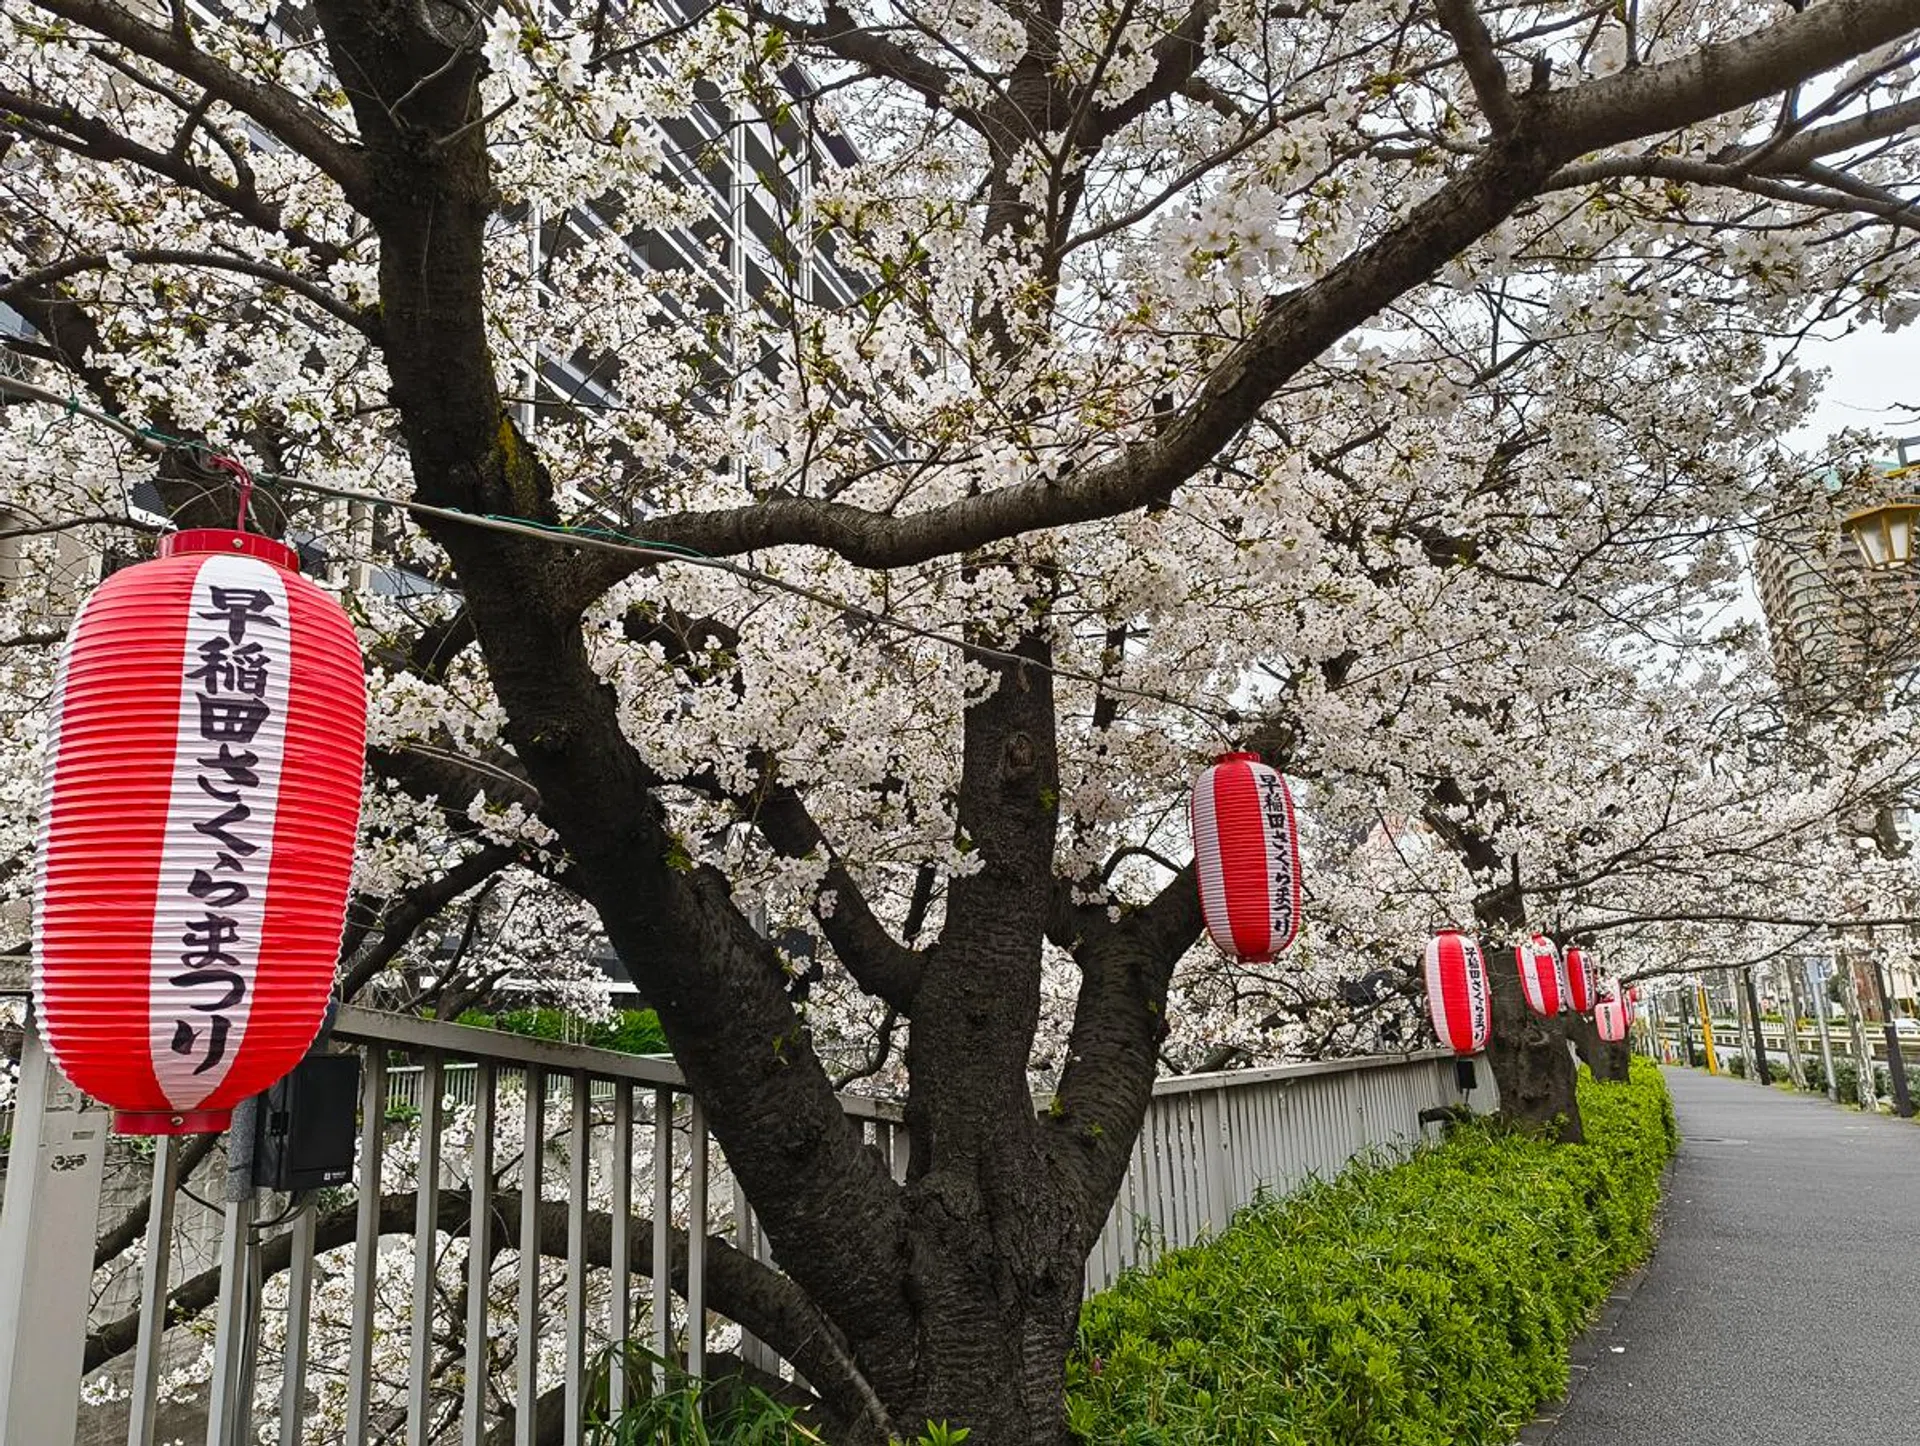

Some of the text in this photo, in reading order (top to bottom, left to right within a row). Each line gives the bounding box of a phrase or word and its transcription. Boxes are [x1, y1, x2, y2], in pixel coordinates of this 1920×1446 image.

[169, 585, 281, 1076] 早稲田さくらまつり
[1259, 773, 1291, 938] 早稲田さくらまつり
